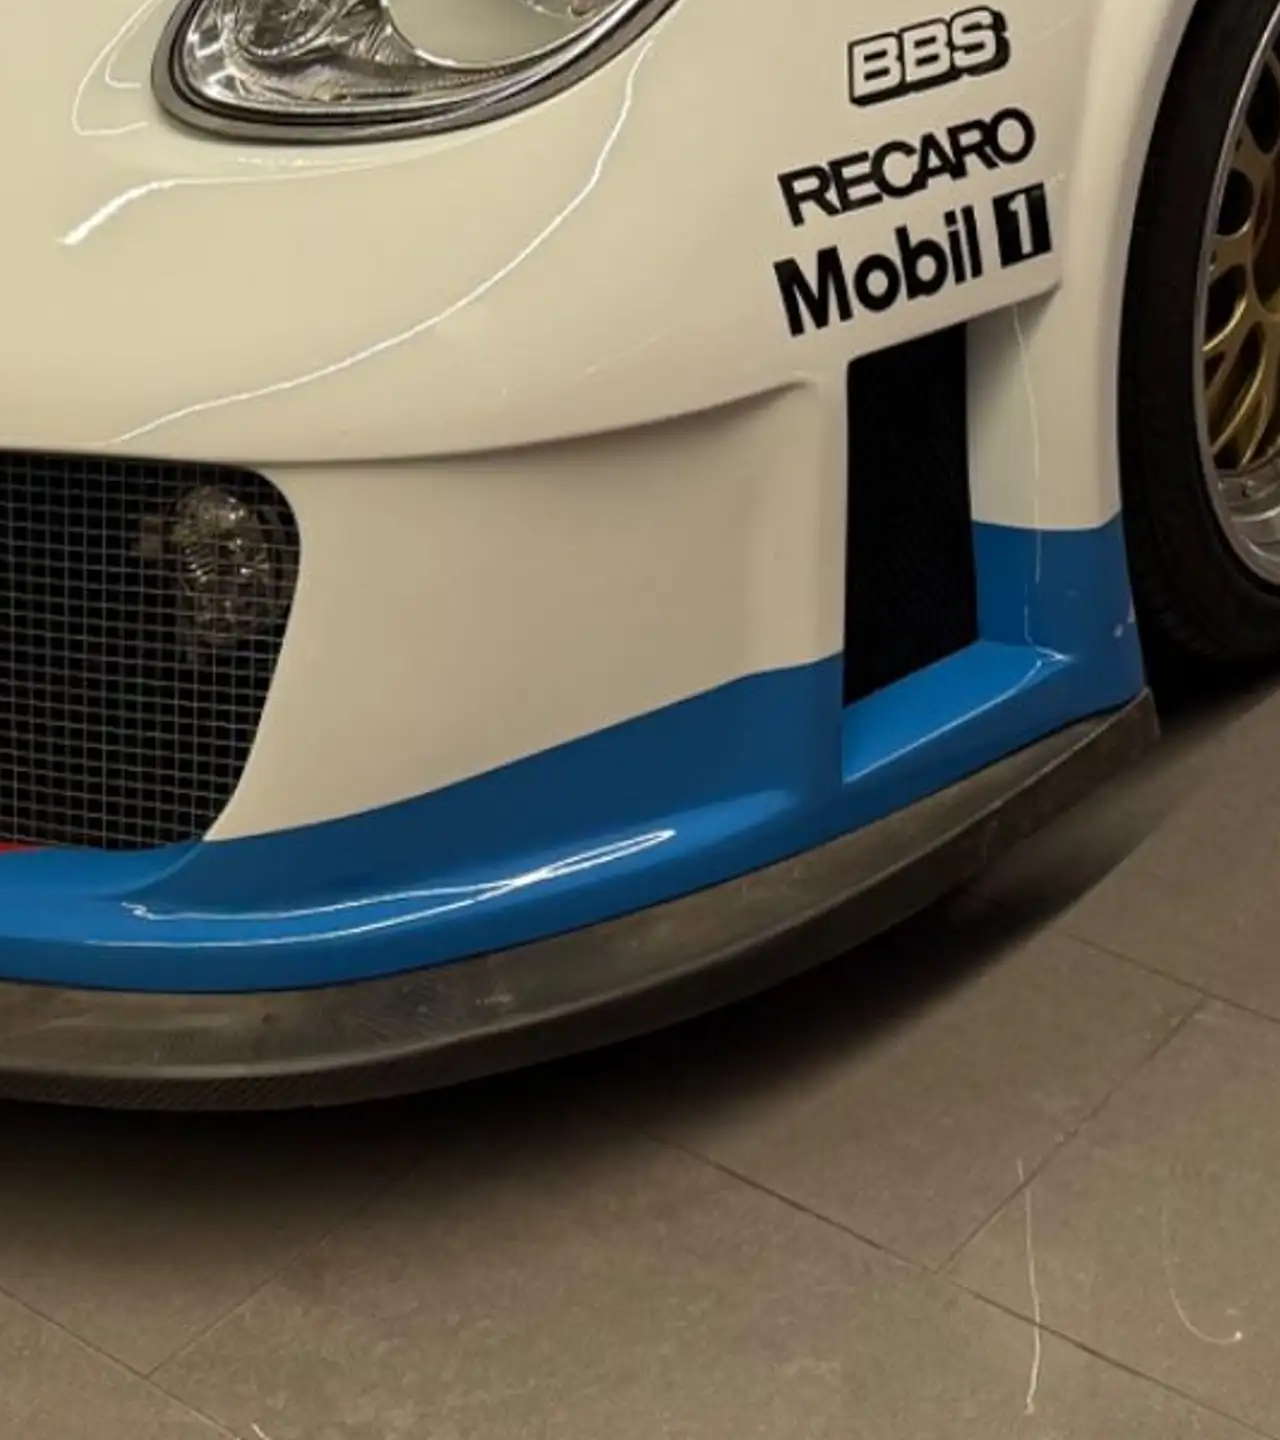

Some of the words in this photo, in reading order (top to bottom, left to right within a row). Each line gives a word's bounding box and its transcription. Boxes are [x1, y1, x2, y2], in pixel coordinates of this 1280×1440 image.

[846, 5, 1011, 108] BBS
[776, 106, 1037, 228] RECARO
[771, 204, 984, 338] Mobil
